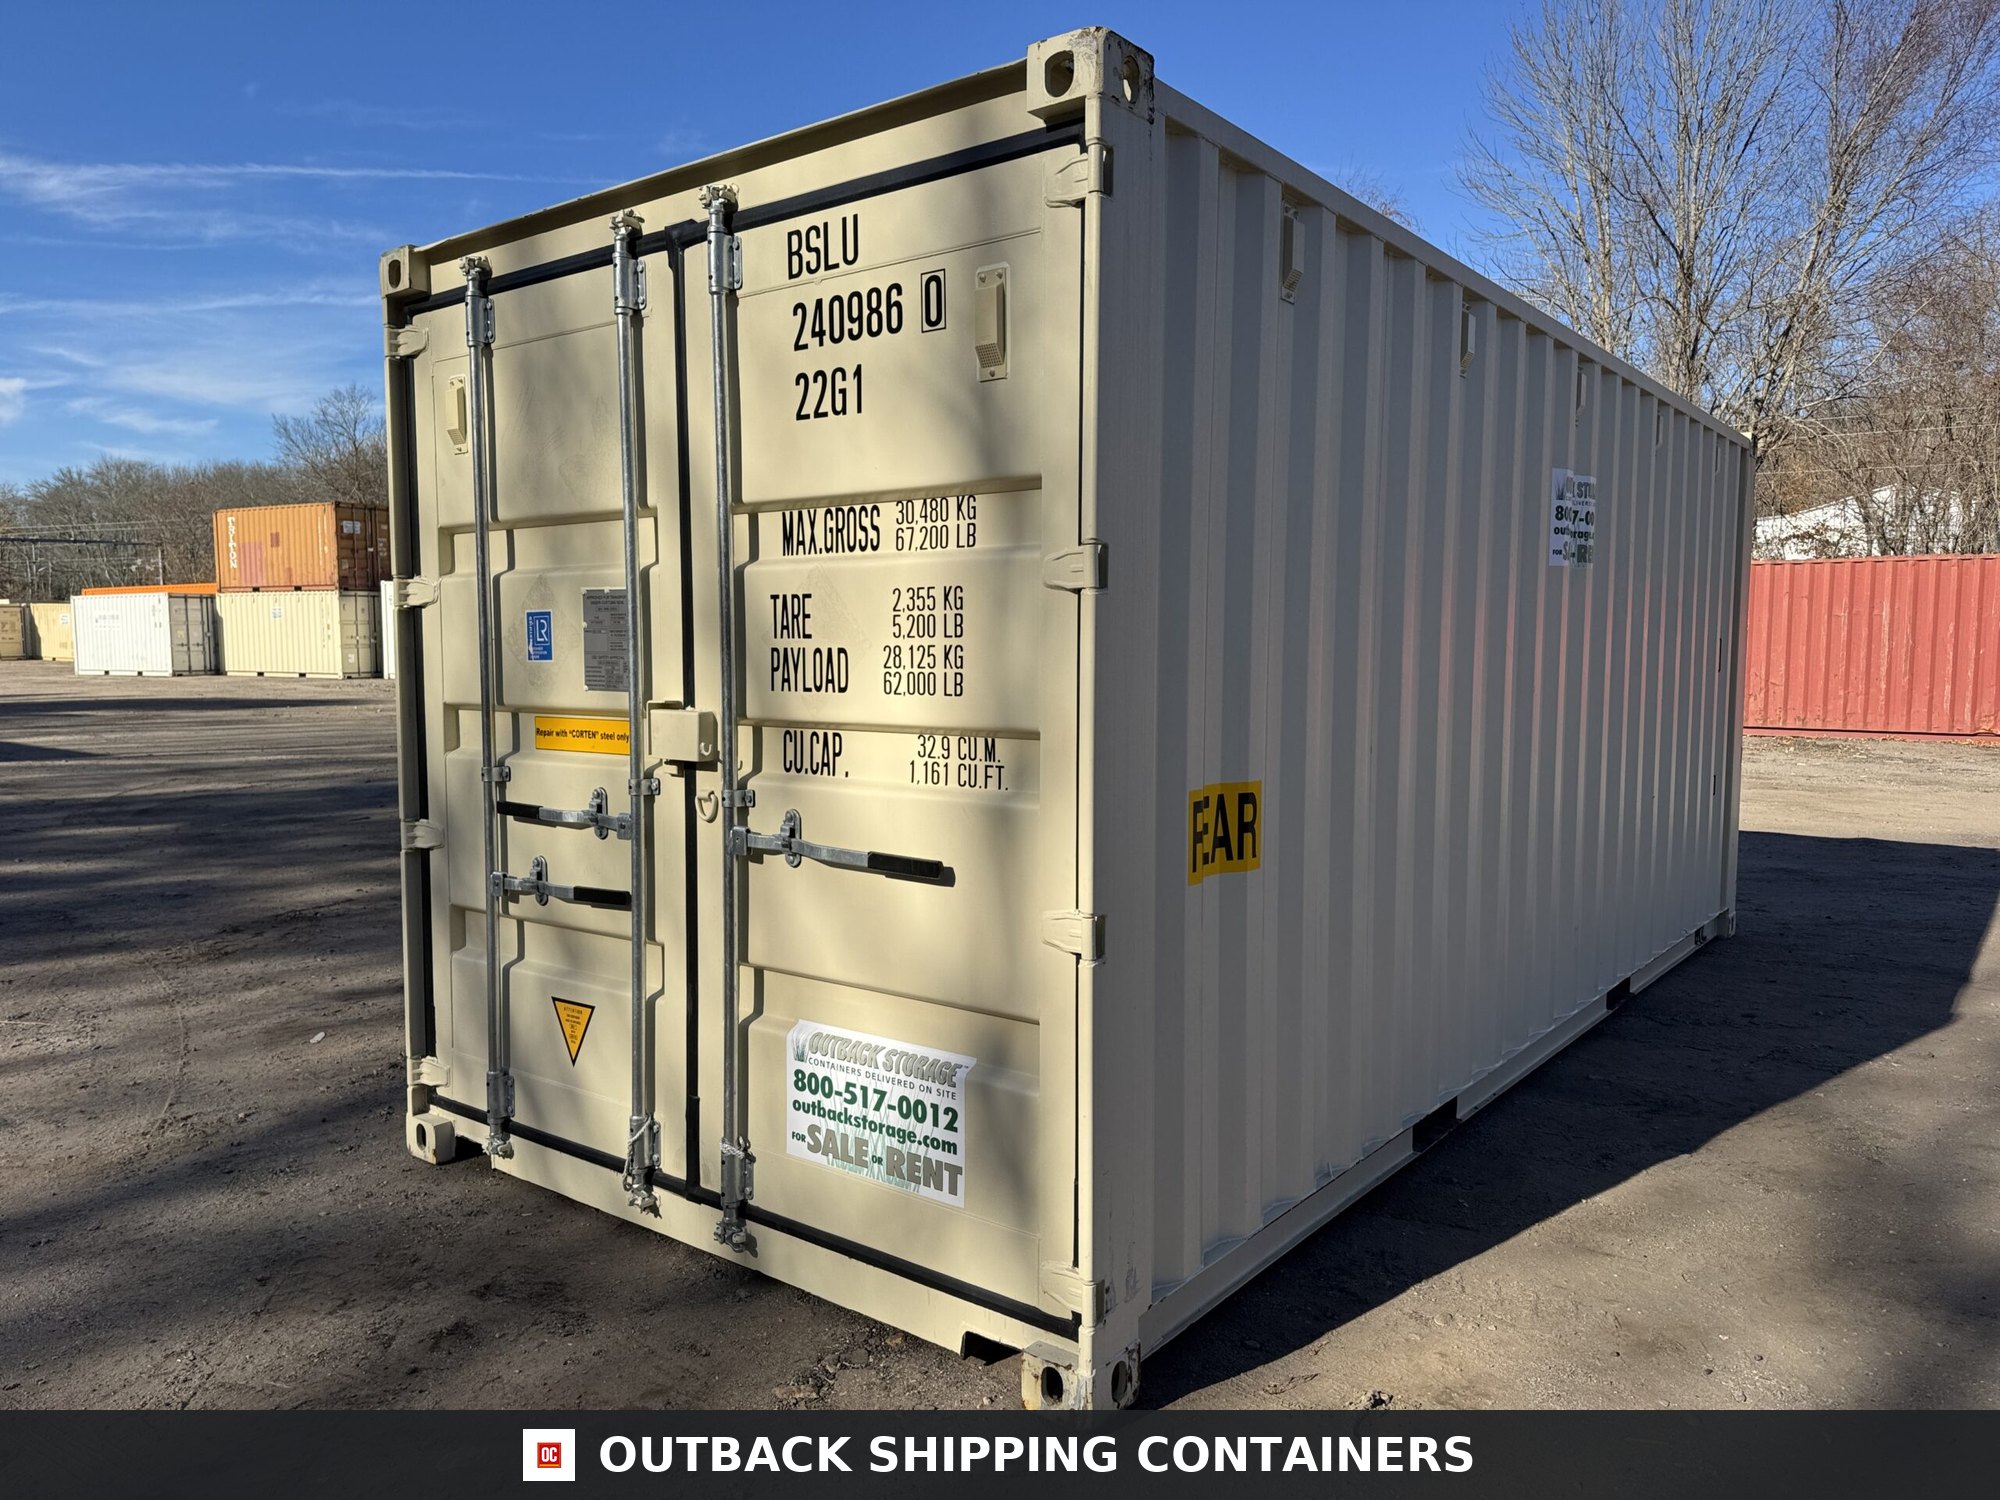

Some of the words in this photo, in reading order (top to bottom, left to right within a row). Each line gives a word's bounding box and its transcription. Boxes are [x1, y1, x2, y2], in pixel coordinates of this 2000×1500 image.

[787, 213, 859, 280] BSLU
[792, 282, 904, 352] 240986
[923, 273, 943, 328] 0
[794, 363, 863, 421] 22G1
[227, 516, 238, 569] TRITON
[781, 504, 881, 556] MAX.GROSS
[895, 497, 949, 525] 30,480
[956, 495, 977, 521] KG
[895, 525, 949, 551] 67,200
[956, 523, 977, 549] LB
[536, 619, 548, 642] LR
[770, 593, 813, 639] TARE
[892, 587, 936, 613] 2,355
[943, 585, 964, 611] KG
[892, 614, 937, 640] 5,200
[943, 613, 964, 638] LB
[770, 647, 849, 694] PAYLOAD
[883, 645, 937, 670] 28,125
[943, 645, 964, 670] KG
[883, 672, 937, 697] 62,000
[943, 671, 964, 697] LB
[536, 727, 554, 738] Repair
[555, 729, 567, 737] with
[600, 732, 615, 741] steel
[616, 733, 630, 743] only
[917, 734, 951, 760] 32.9
[909, 760, 950, 786] 1,161
[808, 1031, 886, 1069] OUTBACK
[882, 1048, 964, 1089] STORAGE
[808, 1057, 862, 1077] CONTAINERS
[865, 1072, 915, 1090] DELIVERED
[918, 1084, 933, 1094] ON
[936, 1089, 957, 1101] SITE
[792, 1099, 958, 1156] outbackstorage.com
[793, 1068, 959, 1134] 800-517-0012
[791, 1131, 807, 1143] FOR
[806, 1123, 869, 1169] SALE
[871, 1155, 884, 1166] OR
[885, 1146, 963, 1196] RENT
